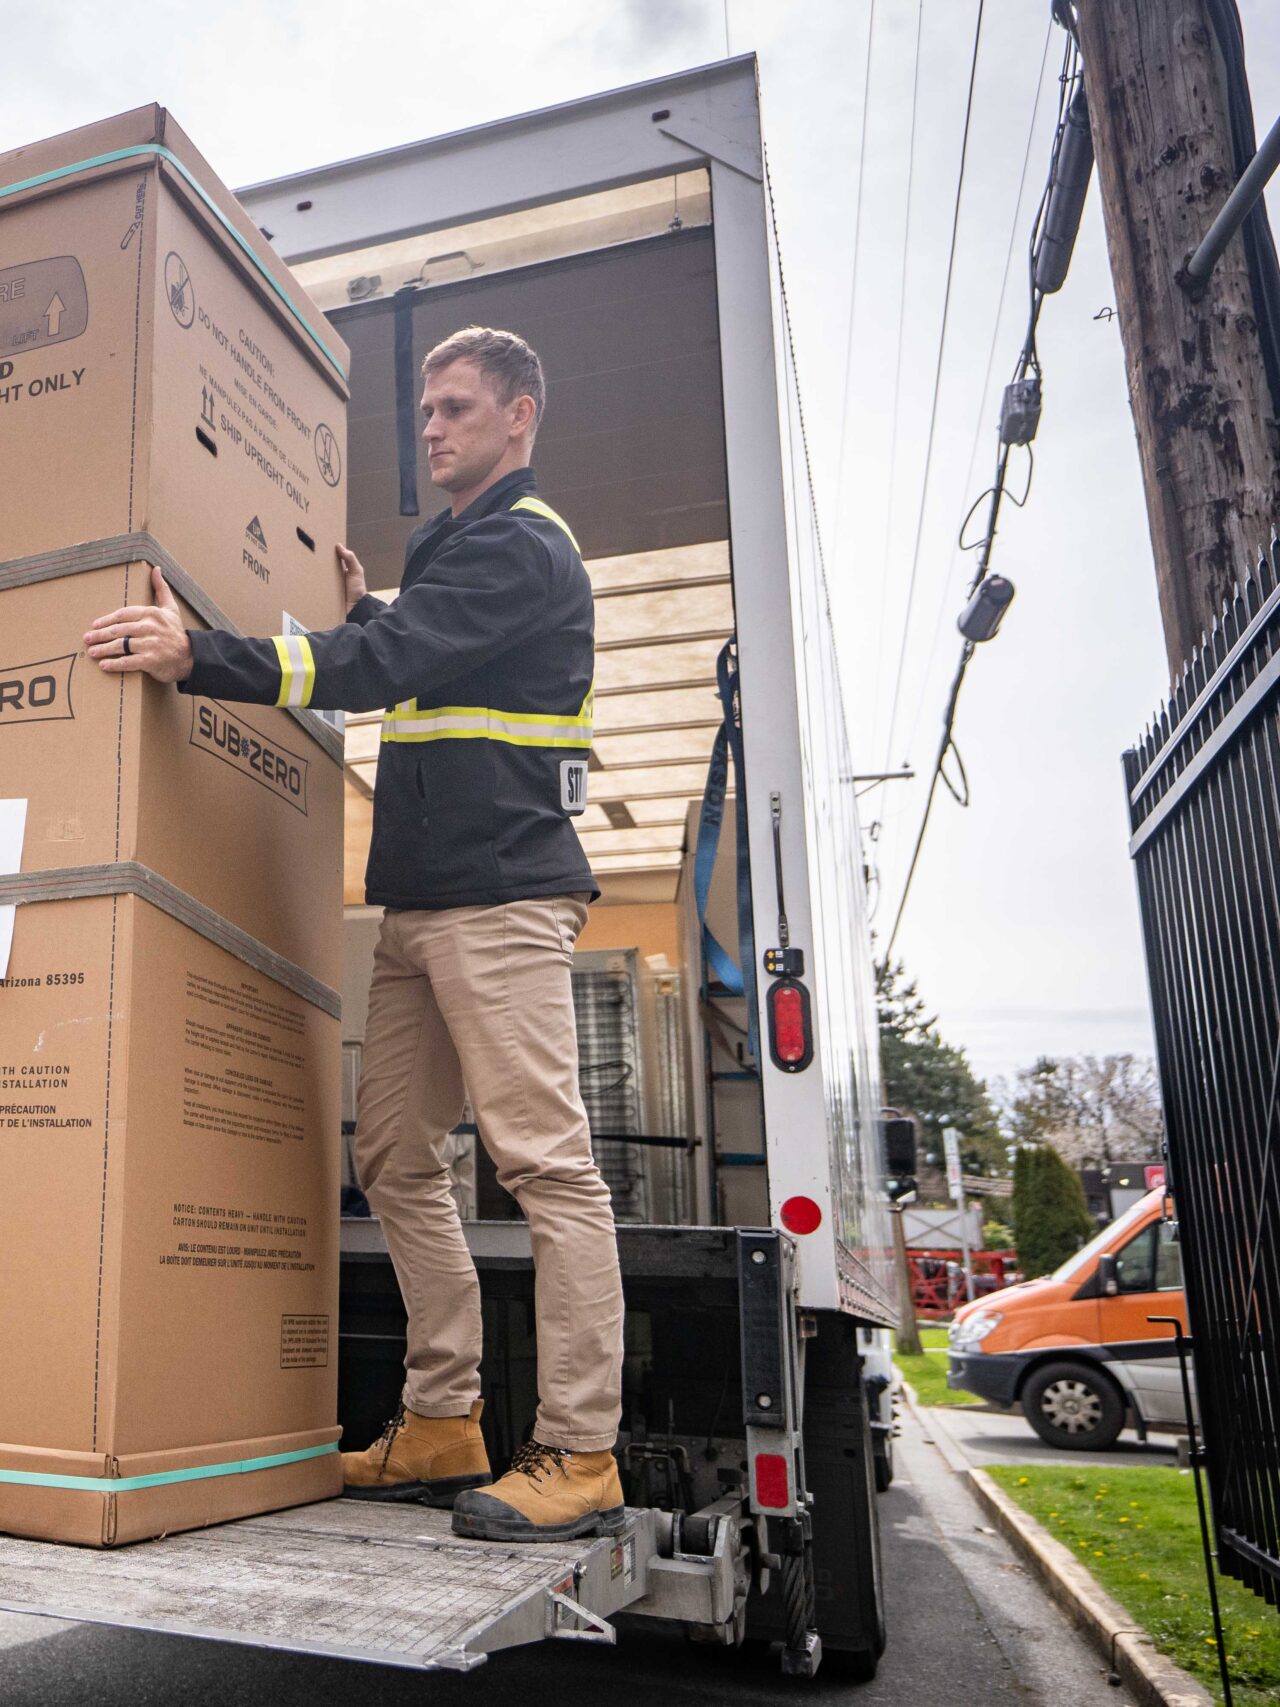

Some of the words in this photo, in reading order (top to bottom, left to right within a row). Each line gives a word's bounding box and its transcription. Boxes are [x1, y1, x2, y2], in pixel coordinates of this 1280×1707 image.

[238, 328, 275, 378] CAUTION:
[28, 368, 86, 397] ONLY
[198, 306, 211, 330] DO
[212, 323, 229, 350] NOT
[230, 344, 263, 389] HANDLE
[263, 381, 286, 413] FROM
[286, 407, 311, 440] FRONT
[209, 374, 241, 417] MANIPULEZ
[242, 411, 253, 429] PAS
[220, 414, 242, 444] SHIP
[244, 439, 284, 489] UPRIGHT
[286, 481, 310, 513] ONLY
[242, 548, 270, 585] FRONT
[46, 973, 85, 985] 85395
[21, 1065, 70, 1075] CAUTION
[0, 1103, 57, 1114] PRÉCAUTION
[7, 1118, 19, 1128] DE
[22, 1118, 92, 1128] L'INSTALLATION
[174, 1204, 196, 1214] NOTICE:
[198, 1206, 226, 1217] CONTENTS
[228, 1209, 244, 1218] HEAVY
[173, 1217, 196, 1227] CARTON
[196, 1219, 217, 1229] SHOULD
[219, 1221, 238, 1231] REMAIN
